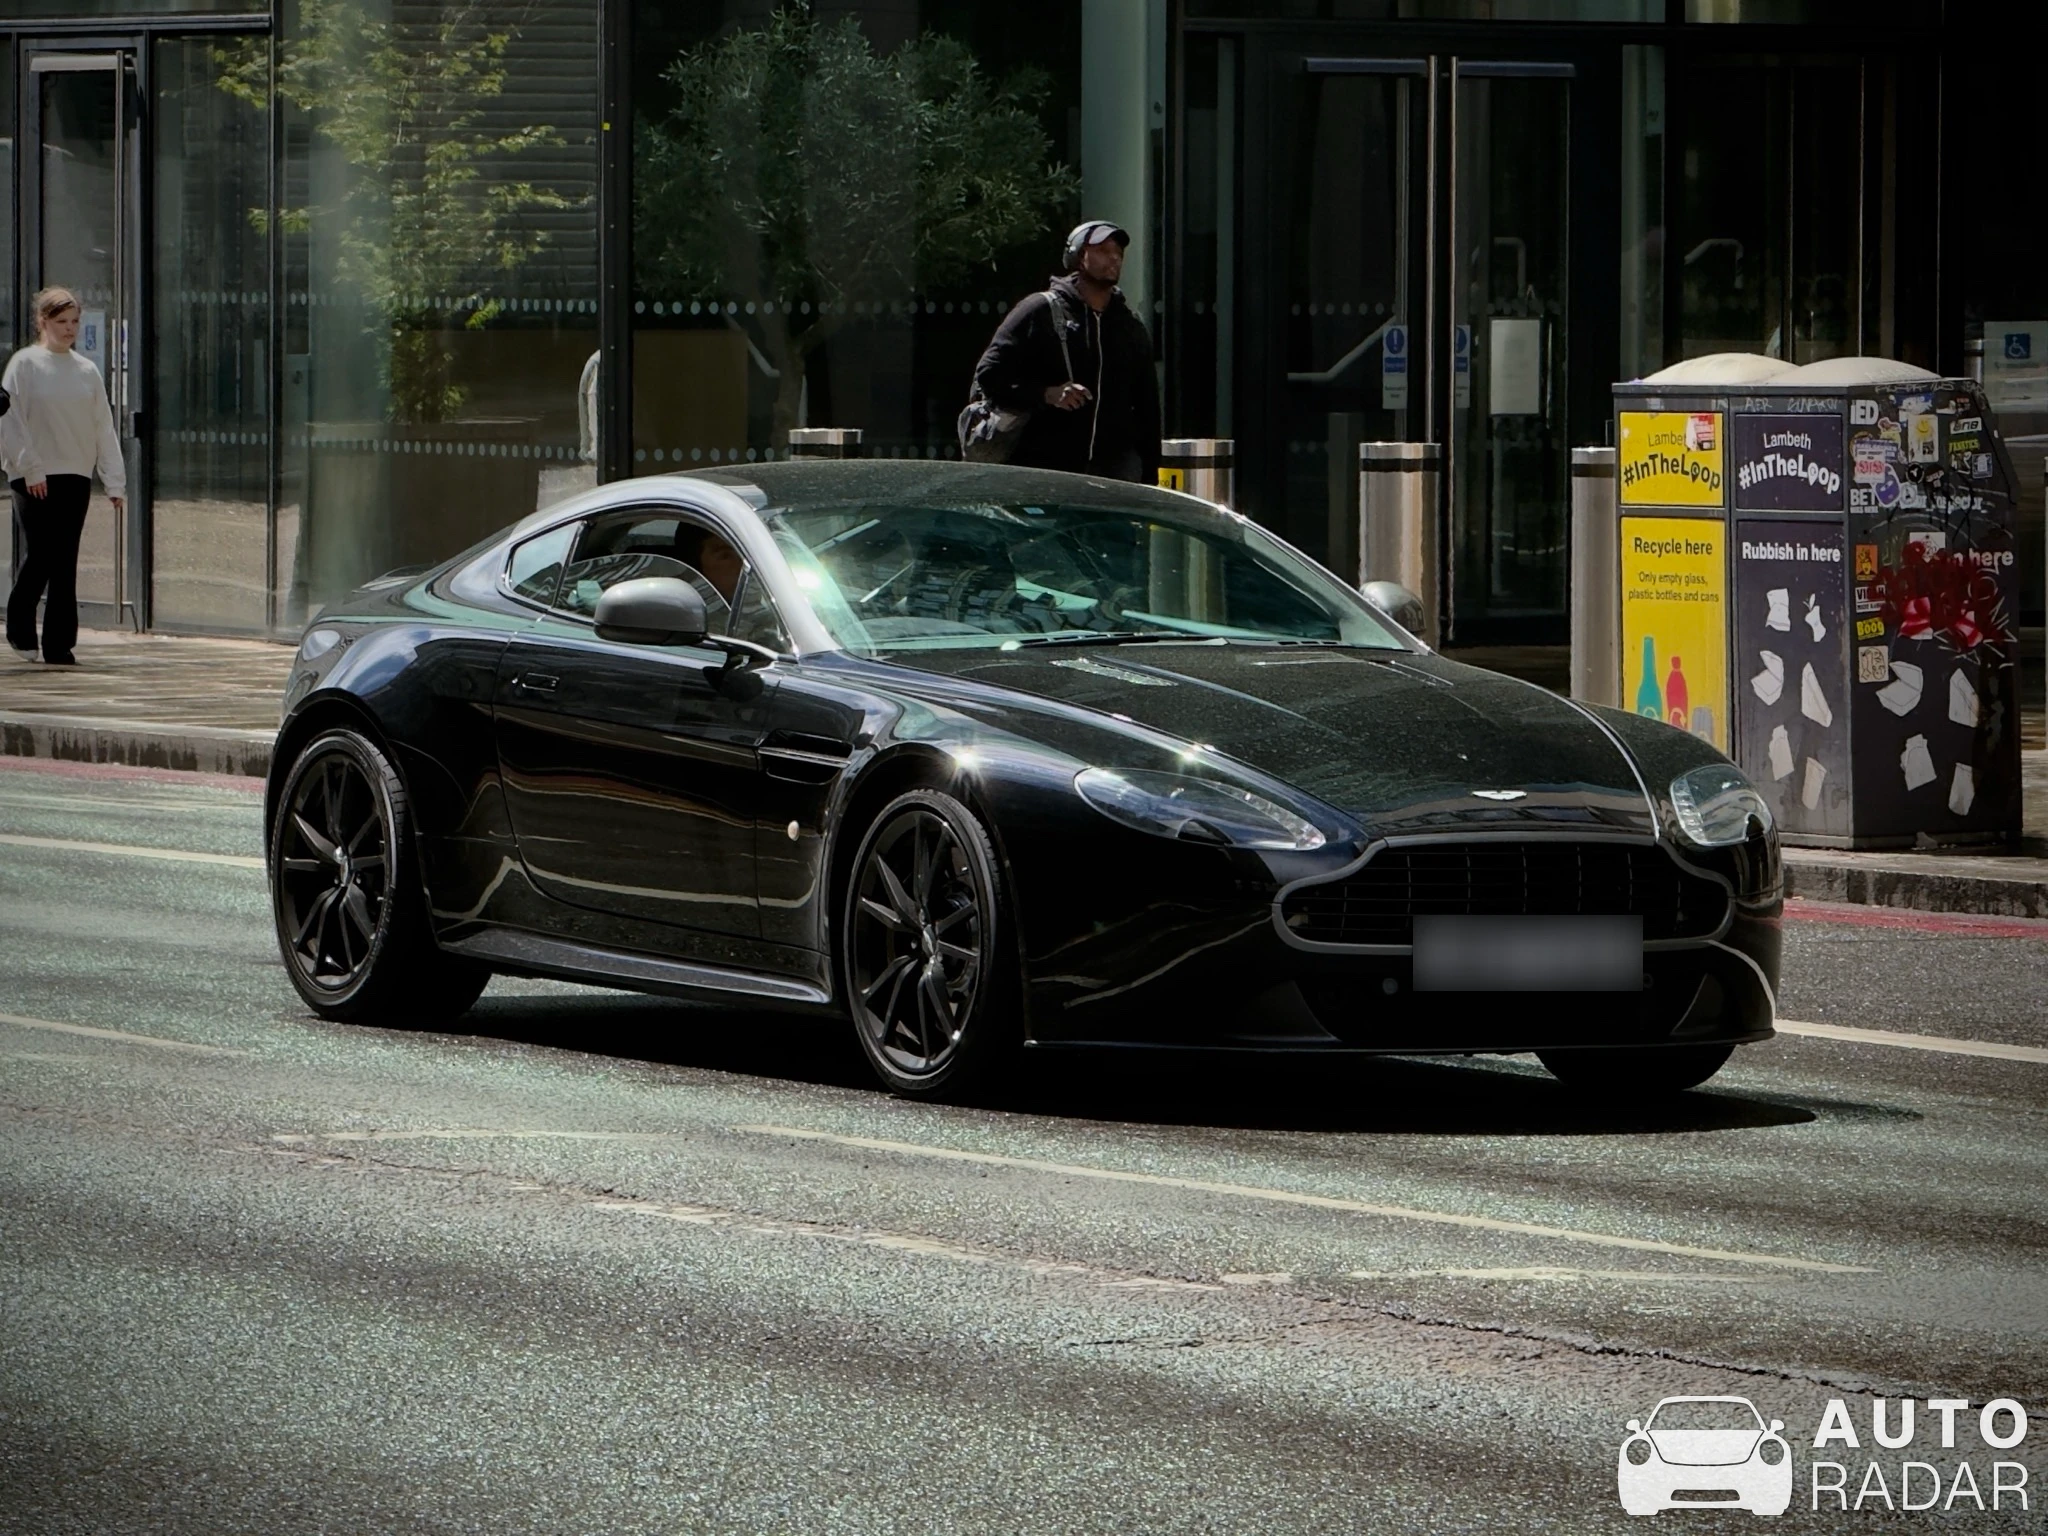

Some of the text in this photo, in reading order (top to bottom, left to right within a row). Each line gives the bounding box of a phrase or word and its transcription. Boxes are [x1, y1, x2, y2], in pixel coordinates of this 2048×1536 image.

[1763, 430, 1812, 450] Lambeth
[1623, 452, 1721, 492] #InTheLoop
[1738, 453, 1840, 495] #InTheLoop
[1634, 536, 1713, 558] Recycle here
[1742, 541, 1841, 563] Rubbish in here
[1968, 547, 2014, 567] here
[1638, 571, 1709, 587] Only empty glass,
[1628, 588, 1720, 603] plastic bottles and cans
